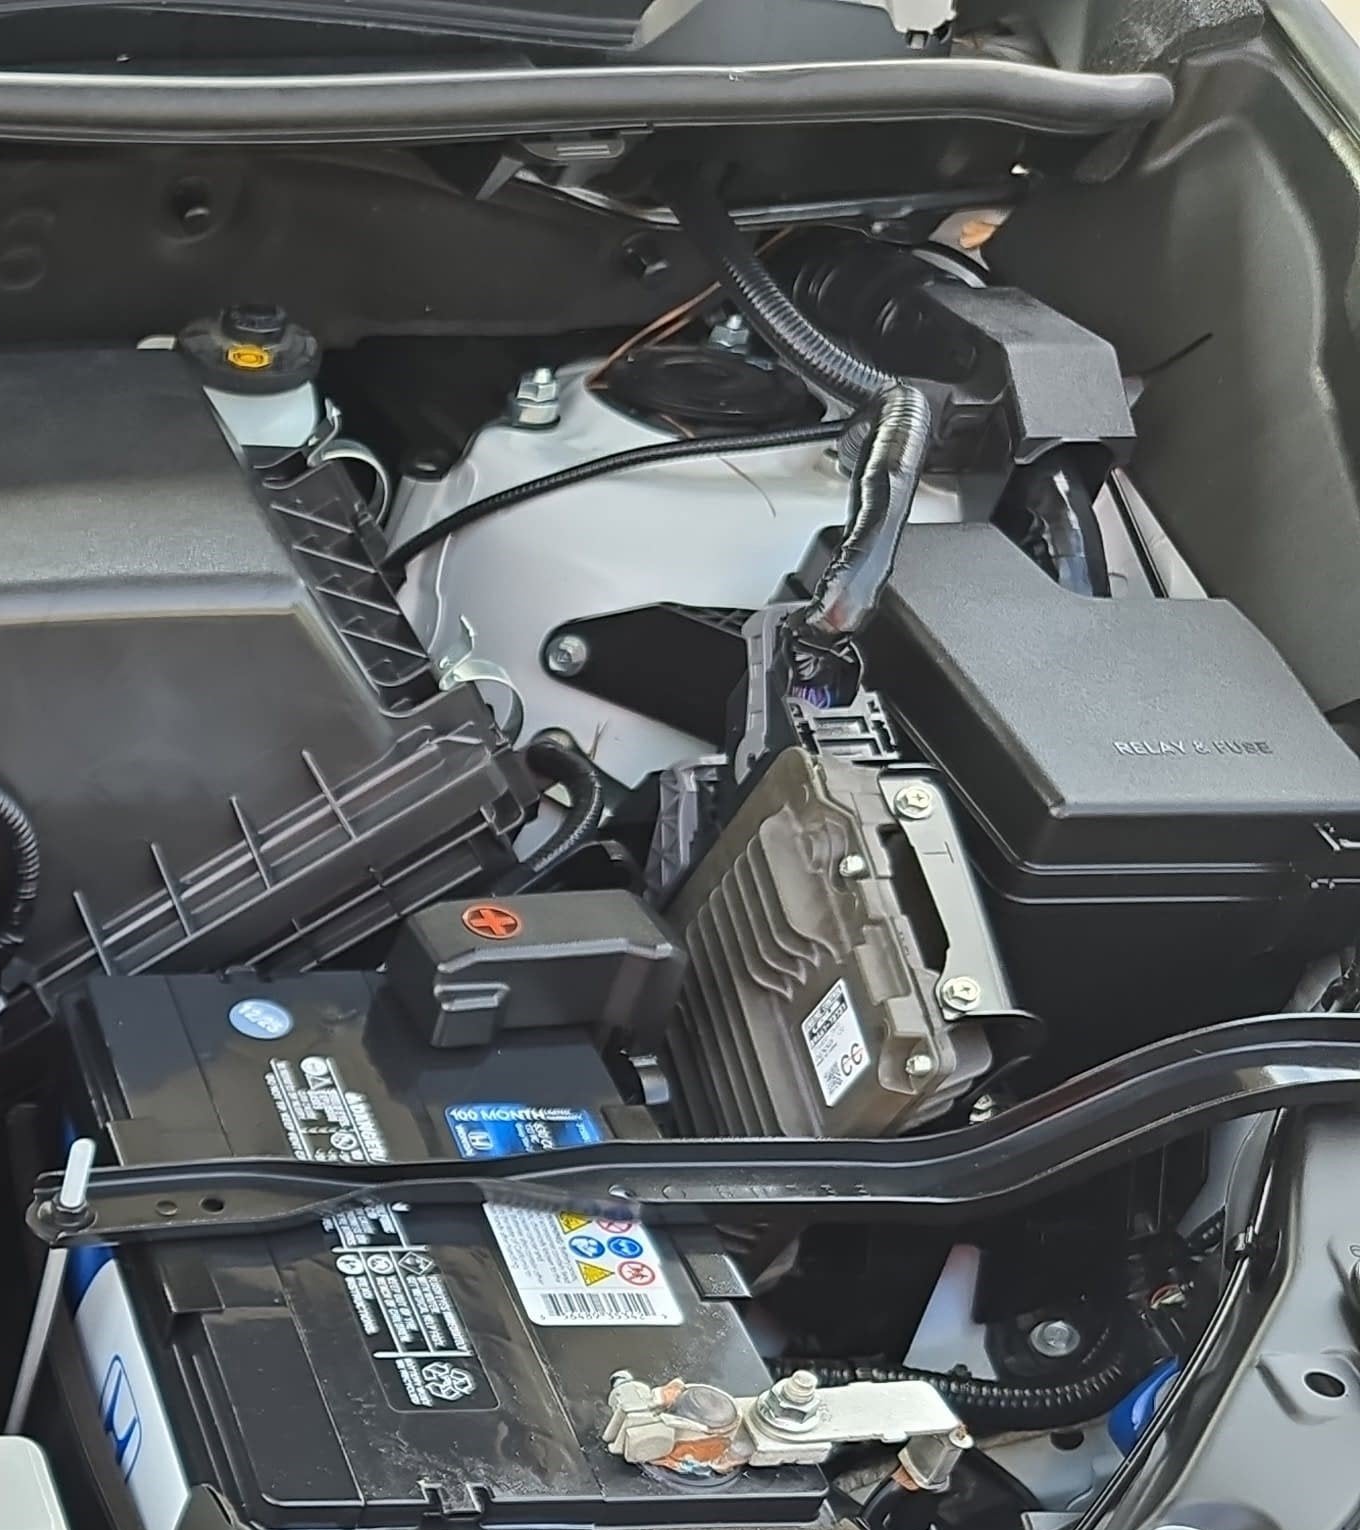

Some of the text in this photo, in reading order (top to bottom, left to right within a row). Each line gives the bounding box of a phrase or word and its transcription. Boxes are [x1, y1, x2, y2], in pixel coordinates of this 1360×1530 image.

[1112, 740, 1187, 756] RELAY
[1212, 740, 1274, 755] FUSE
[449, 1107, 477, 1122] 100
[480, 1107, 545, 1121] MONTH
